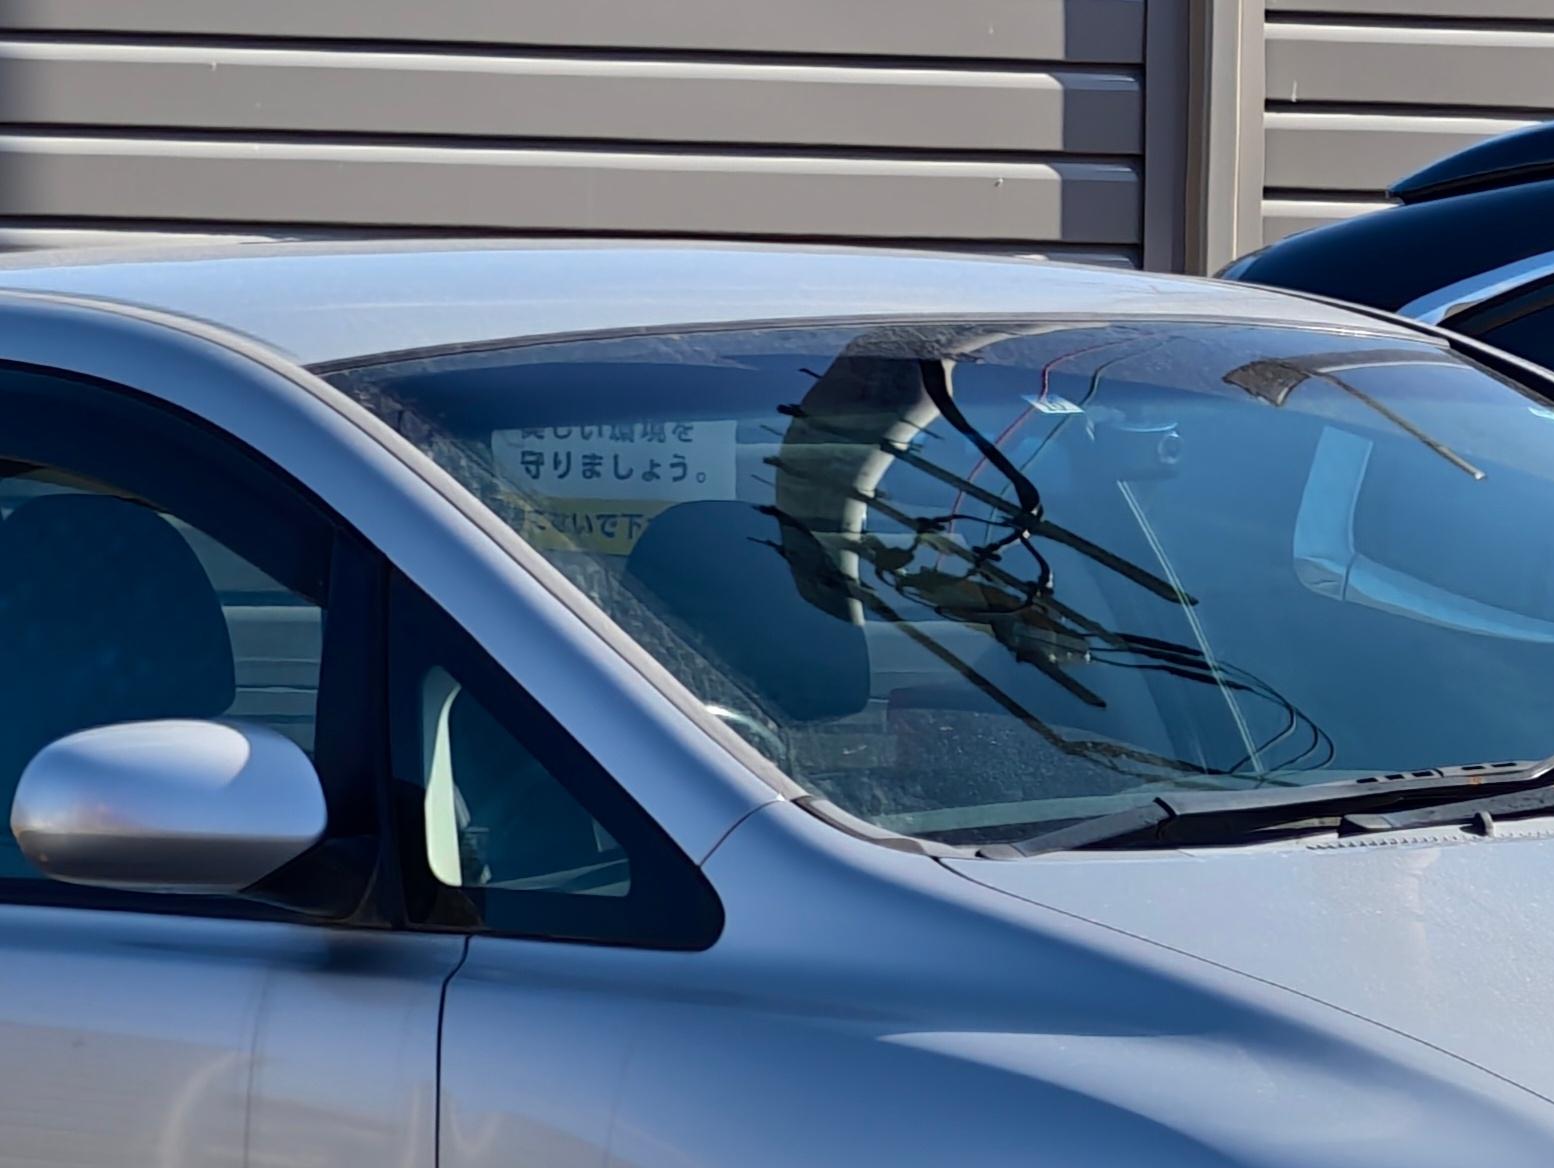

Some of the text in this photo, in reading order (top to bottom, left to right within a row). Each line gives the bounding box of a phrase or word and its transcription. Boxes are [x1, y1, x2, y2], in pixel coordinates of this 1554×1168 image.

[520, 450, 706, 483] 守りましょう。
